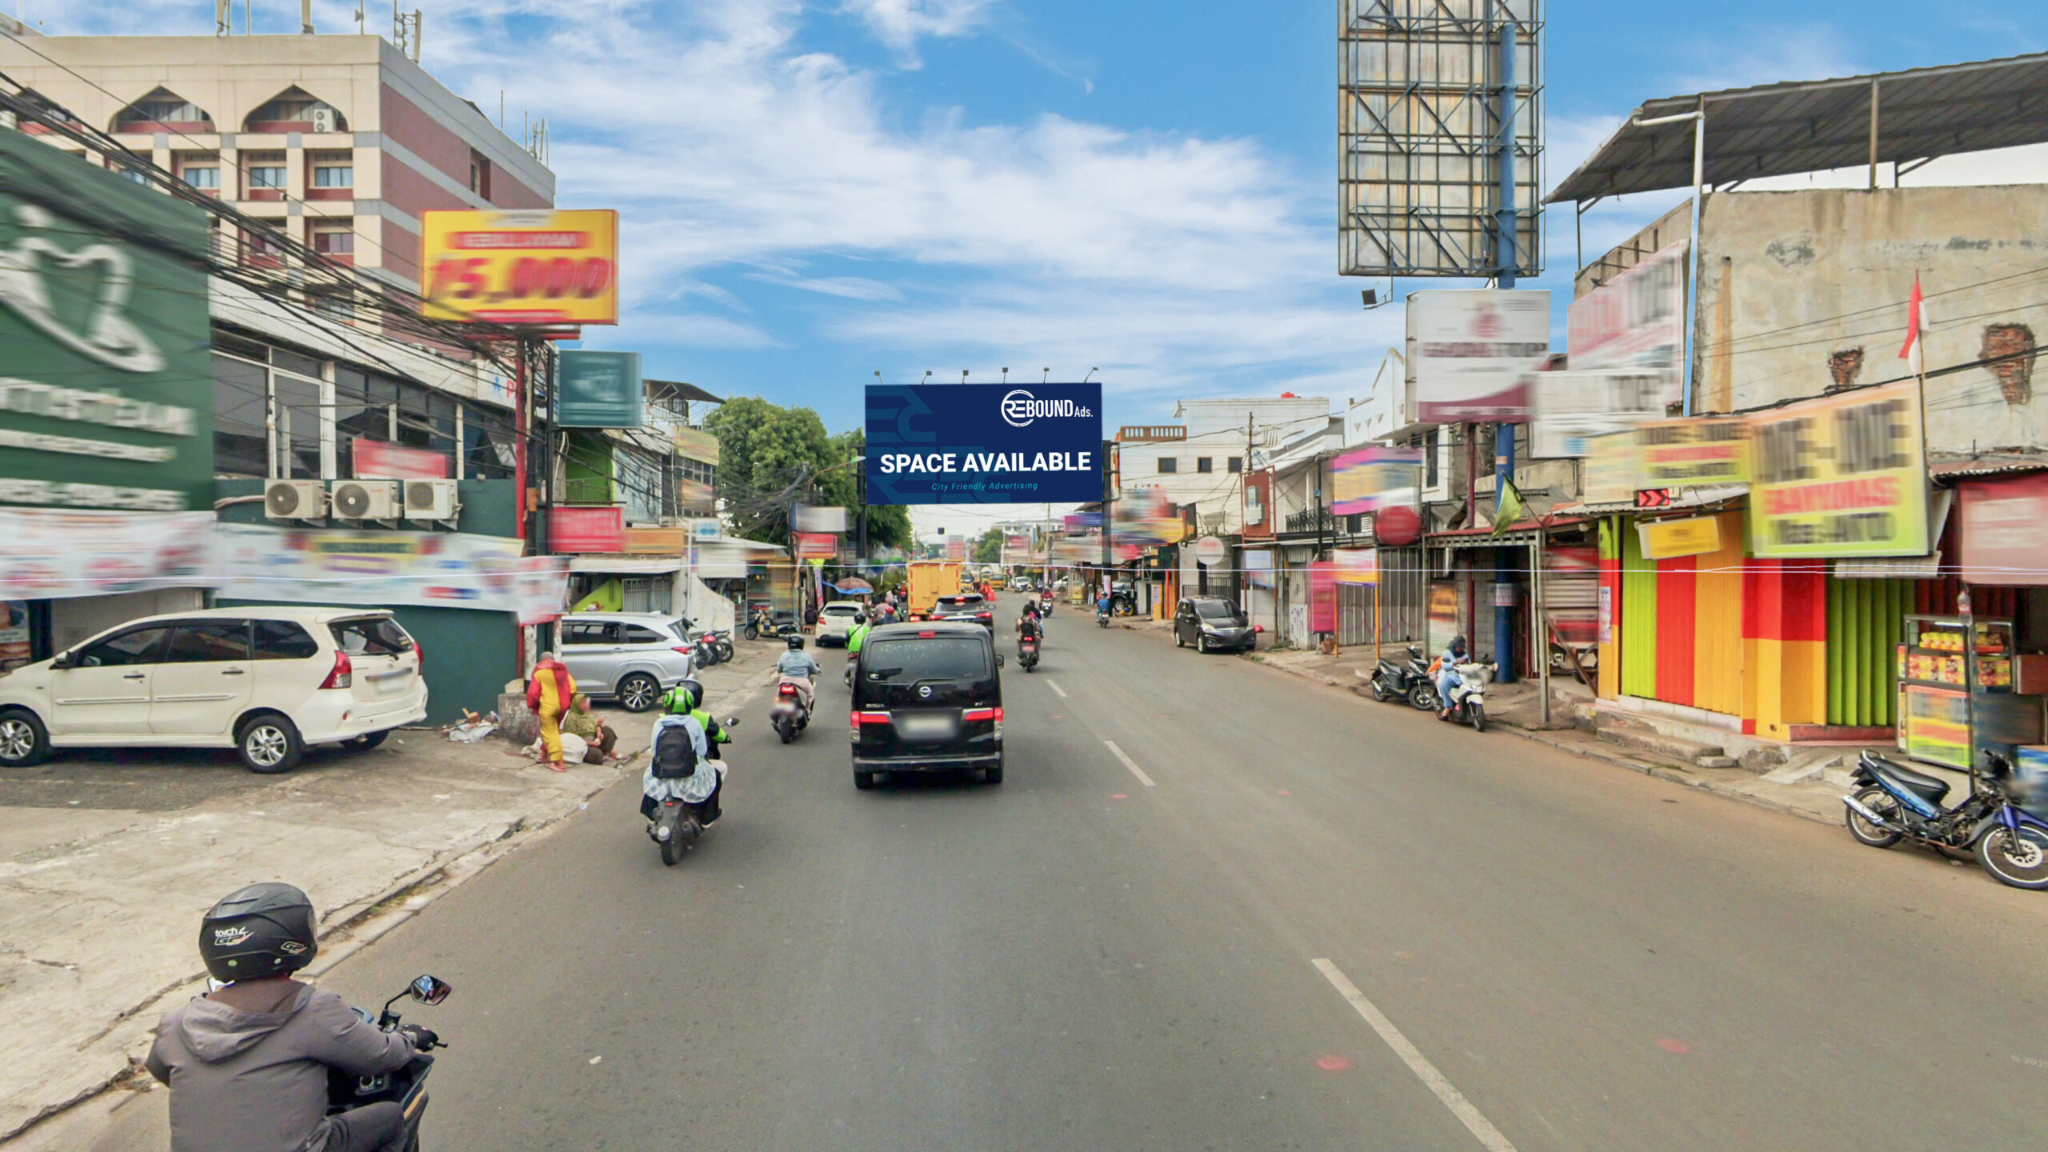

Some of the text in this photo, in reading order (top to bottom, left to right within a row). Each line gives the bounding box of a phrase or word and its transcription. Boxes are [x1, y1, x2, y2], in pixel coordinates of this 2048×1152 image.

[1002, 398, 1094, 419] REBOUND Ads.
[880, 451, 1092, 474] SPACE AVAILABLE
[931, 481, 1038, 492] City Friendly Advertising
